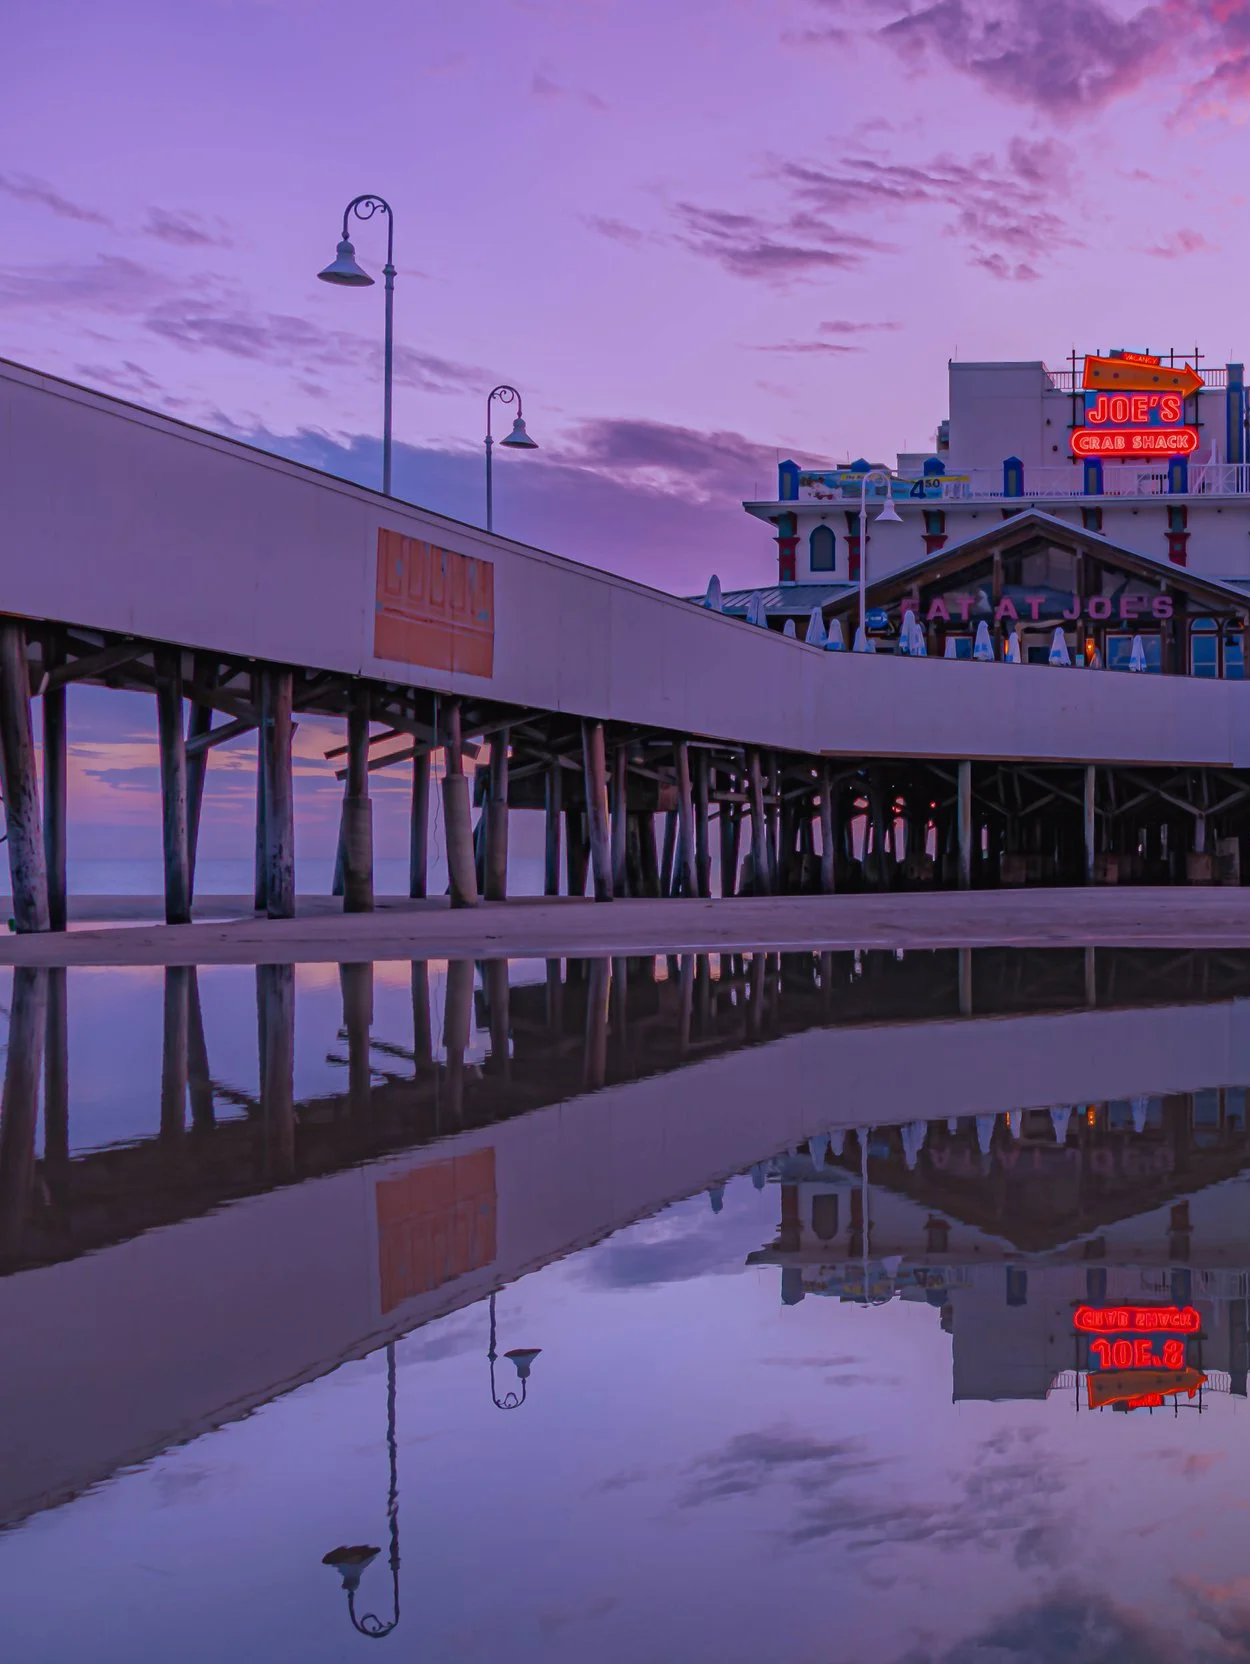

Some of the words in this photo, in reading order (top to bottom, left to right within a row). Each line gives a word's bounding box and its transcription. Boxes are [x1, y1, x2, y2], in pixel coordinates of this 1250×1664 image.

[1124, 354, 1158, 364] VACANCY
[1087, 395, 1181, 424] JOE'S
[1079, 436, 1126, 450] CRAB
[1132, 435, 1189, 449] SHACK
[995, 596, 1047, 621] AT
[1063, 595, 1175, 620] JOE'S
